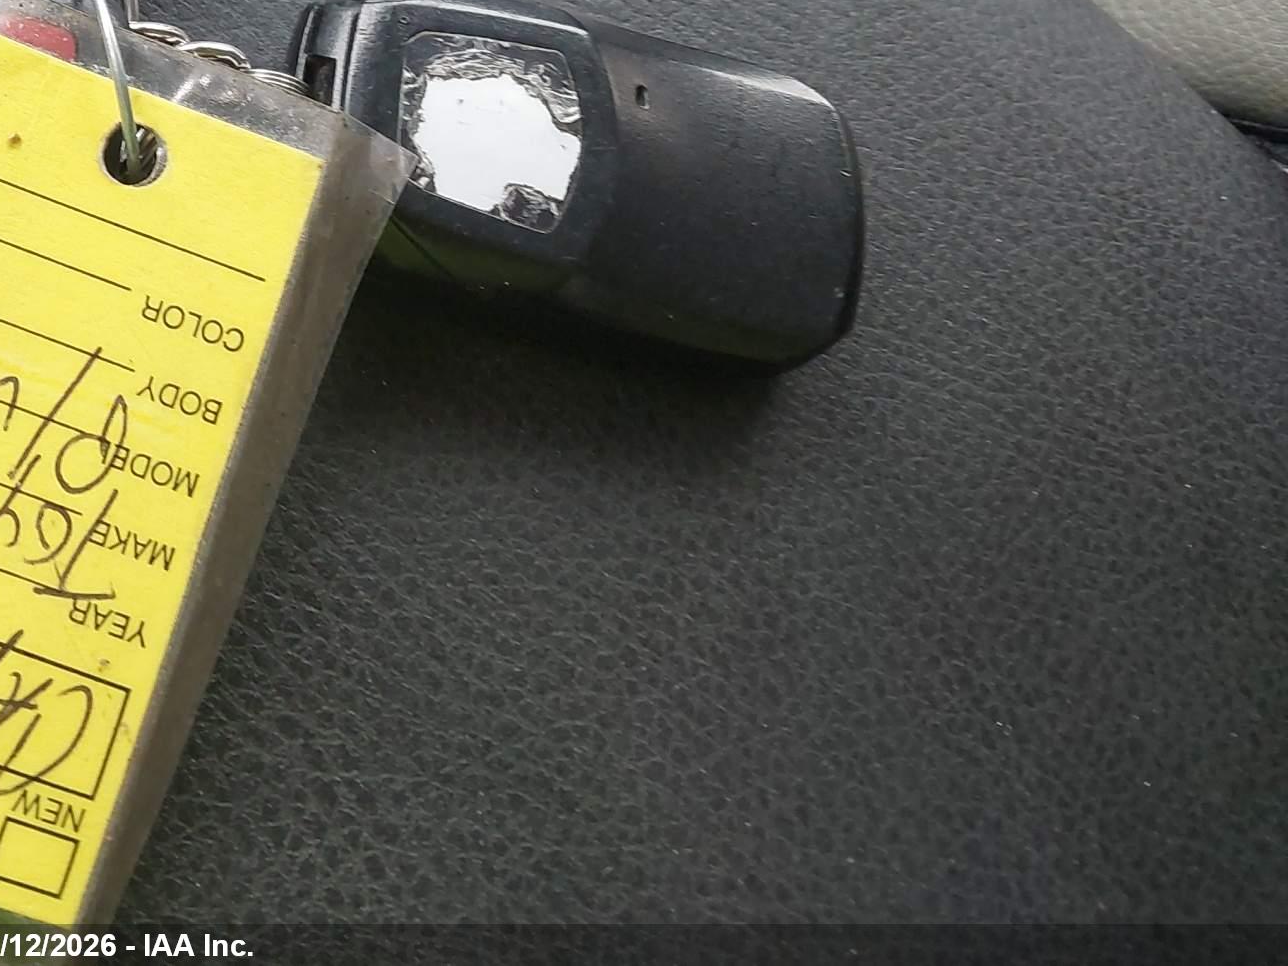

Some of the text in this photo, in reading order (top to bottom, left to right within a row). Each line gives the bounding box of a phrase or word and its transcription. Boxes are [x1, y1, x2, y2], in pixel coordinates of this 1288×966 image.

[142, 295, 244, 352] COLOR
[137, 376, 223, 424] BODY
[89, 519, 176, 571] MAKE
[69, 598, 147, 648] YEAR
[14, 789, 87, 832] NEW
